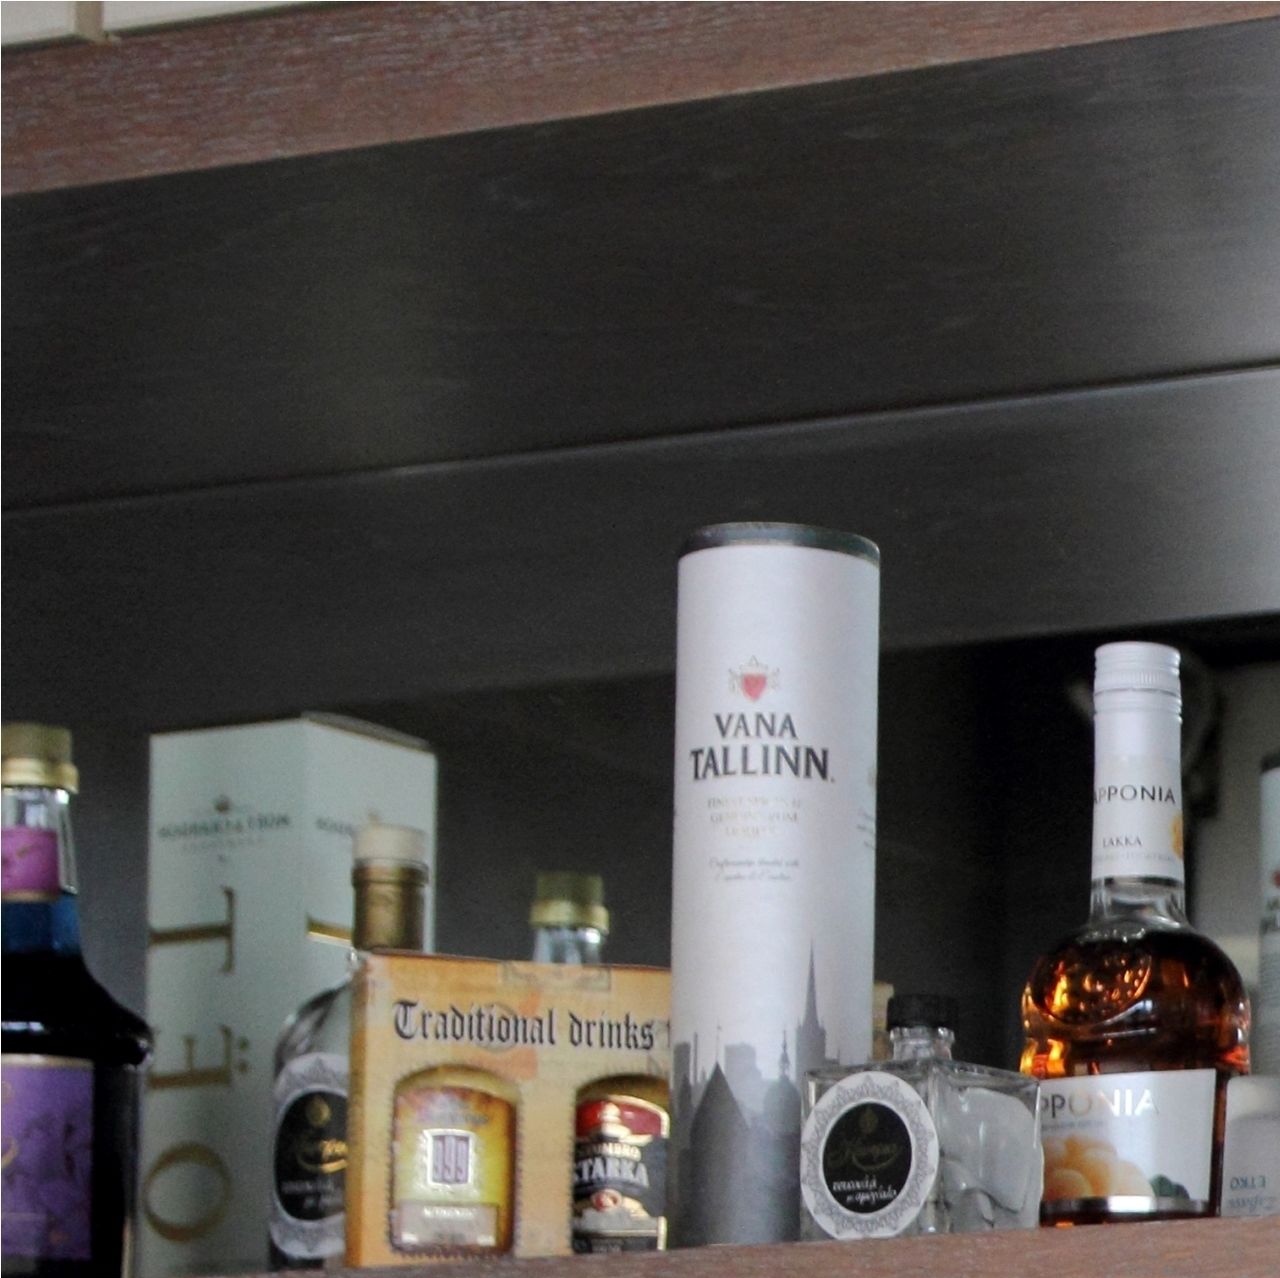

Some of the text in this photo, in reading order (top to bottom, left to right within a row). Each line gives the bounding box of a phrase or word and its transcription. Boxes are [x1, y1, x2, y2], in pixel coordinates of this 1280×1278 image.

[715, 712, 799, 739] VANA
[690, 744, 829, 781] TALLINN
[394, 999, 655, 1050] Traditional drinks
